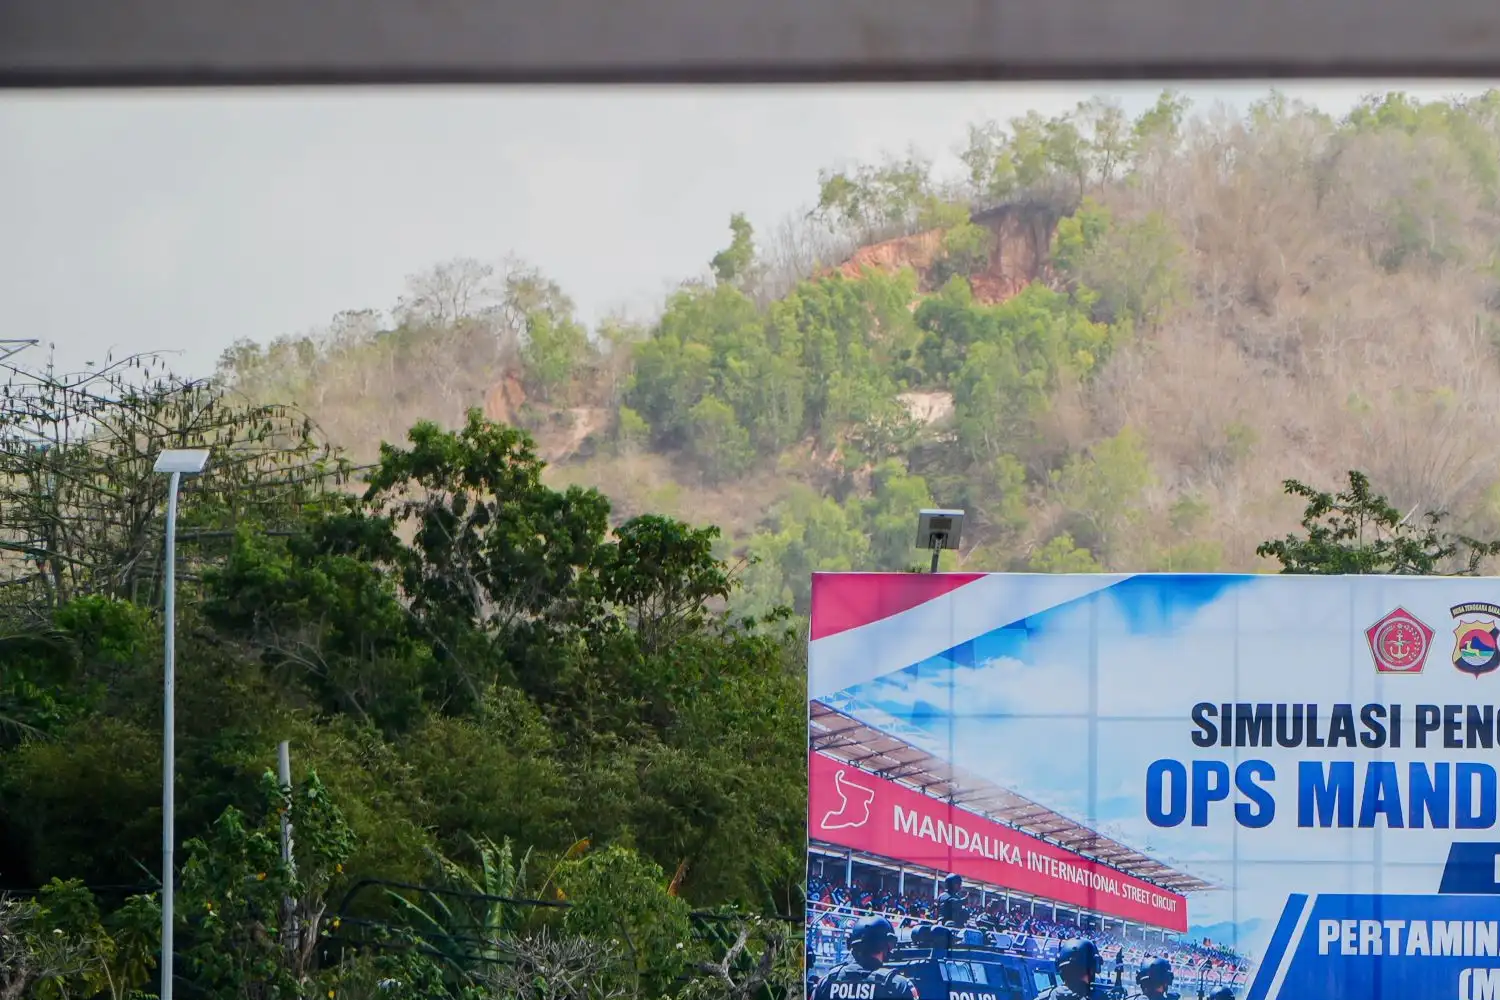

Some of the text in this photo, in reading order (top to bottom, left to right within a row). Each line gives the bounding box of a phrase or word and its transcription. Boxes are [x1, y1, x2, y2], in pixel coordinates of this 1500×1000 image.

[1191, 702, 1401, 748] SIMULASI
[1146, 758, 1276, 829] OPS
[893, 804, 1177, 913] MANDALIKA INTERNATIONAL STREET CIRCUIT
[829, 983, 876, 1000] POLISI
